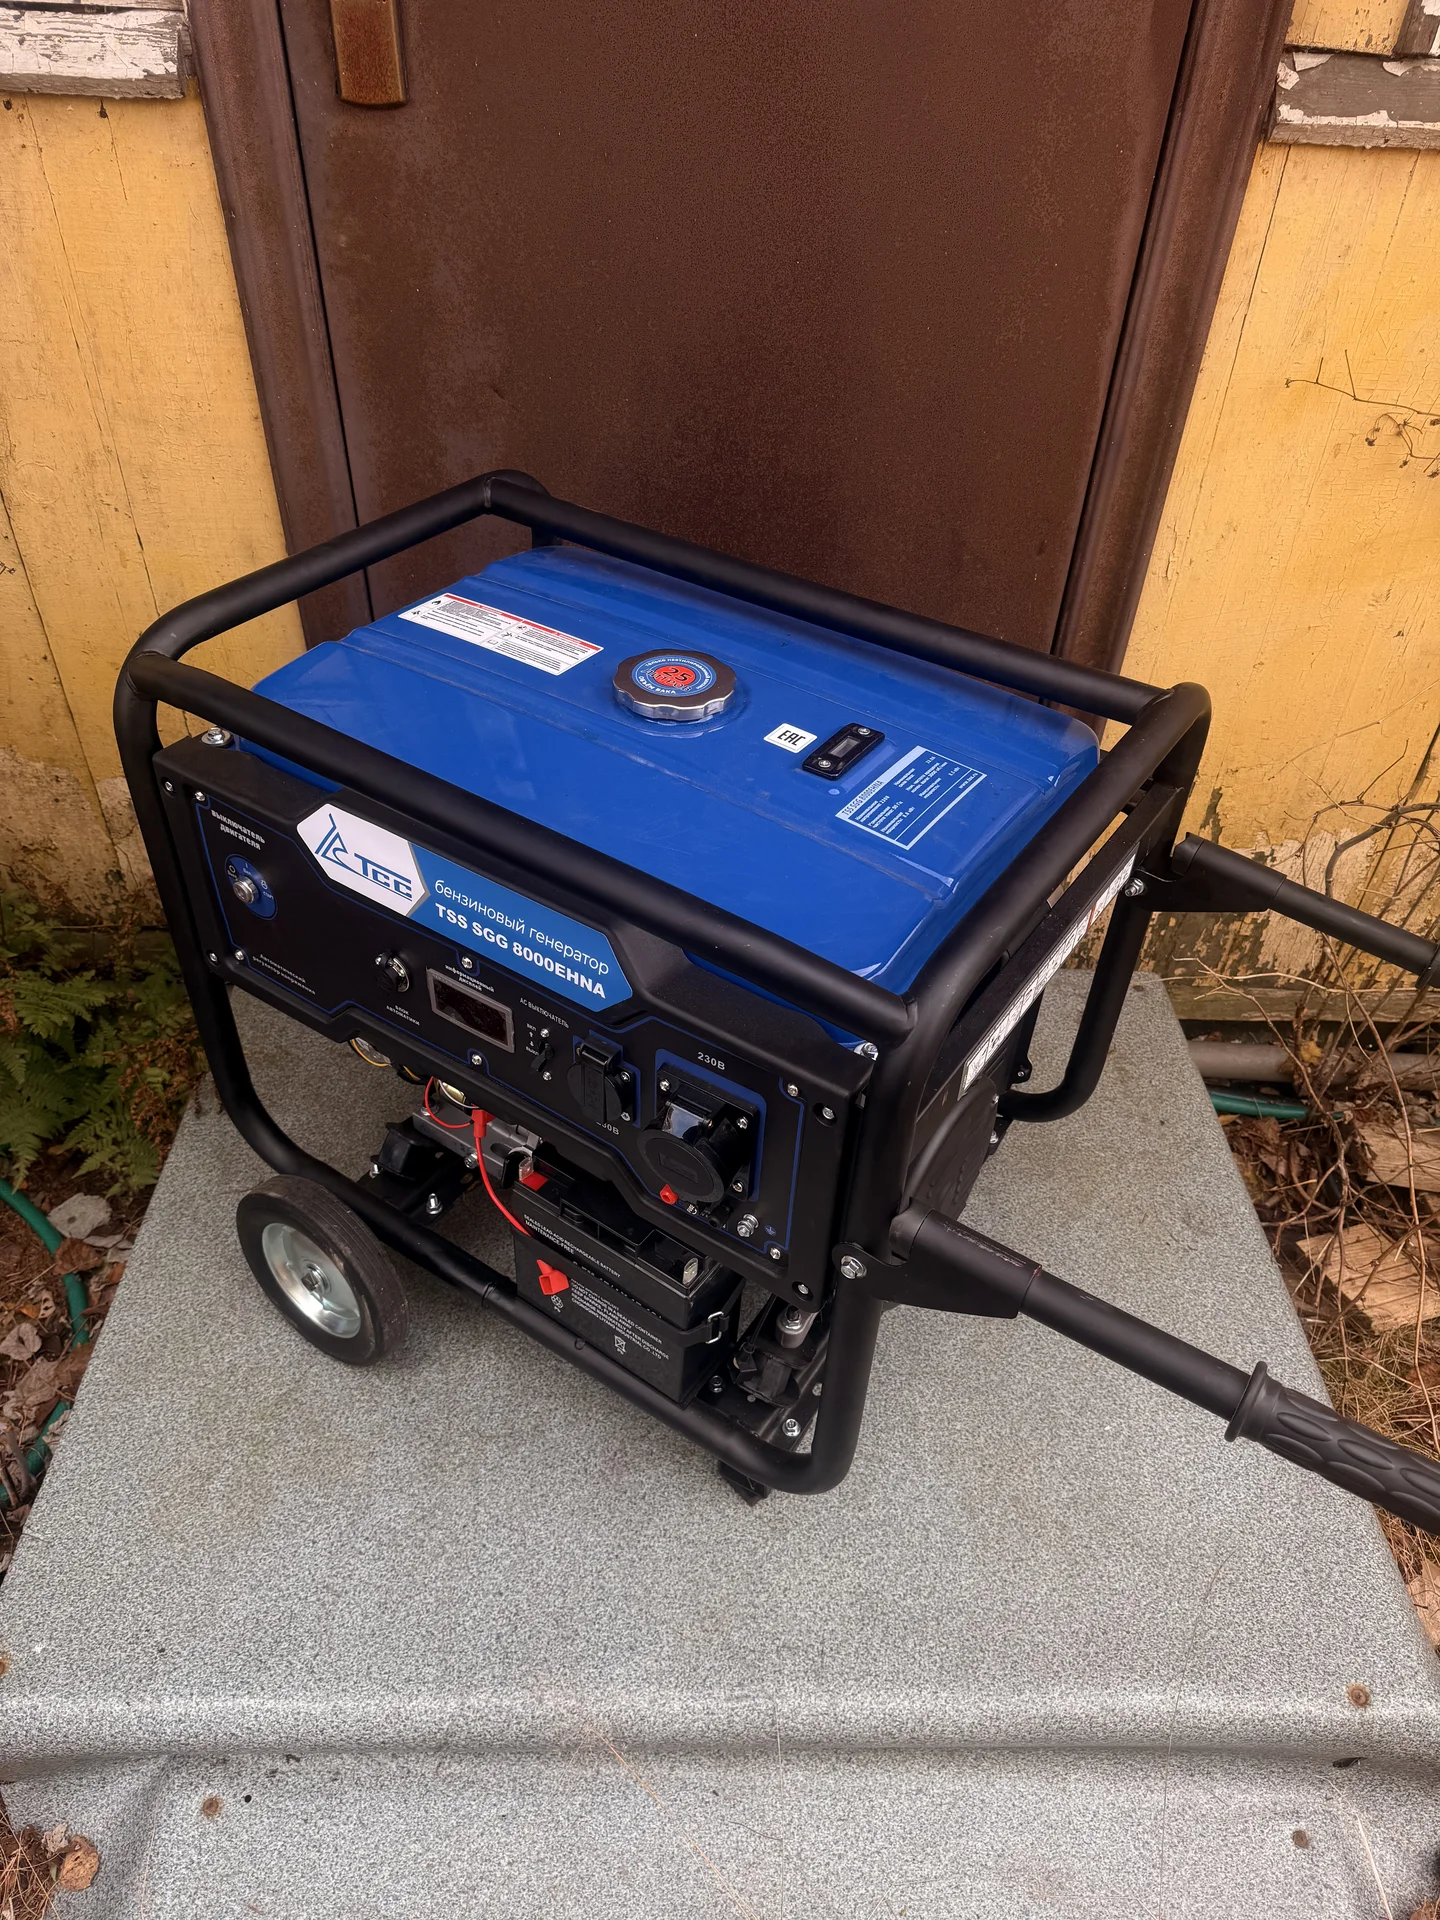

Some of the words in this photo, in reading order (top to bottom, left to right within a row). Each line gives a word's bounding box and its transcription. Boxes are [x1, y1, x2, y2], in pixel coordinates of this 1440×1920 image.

[663, 667, 692, 682] 25
[210, 808, 266, 844] выключатель
[220, 823, 262, 851] двигателя
[434, 879, 525, 935] бензиновый
[529, 927, 610, 976] генератор
[434, 903, 469, 930] TSS
[472, 921, 509, 949] SGG
[512, 941, 607, 999] 8000EHNA
[528, 1001, 570, 1029] ВЫКЛЮЧАТЕЛЬ
[697, 1051, 726, 1071] 230В
